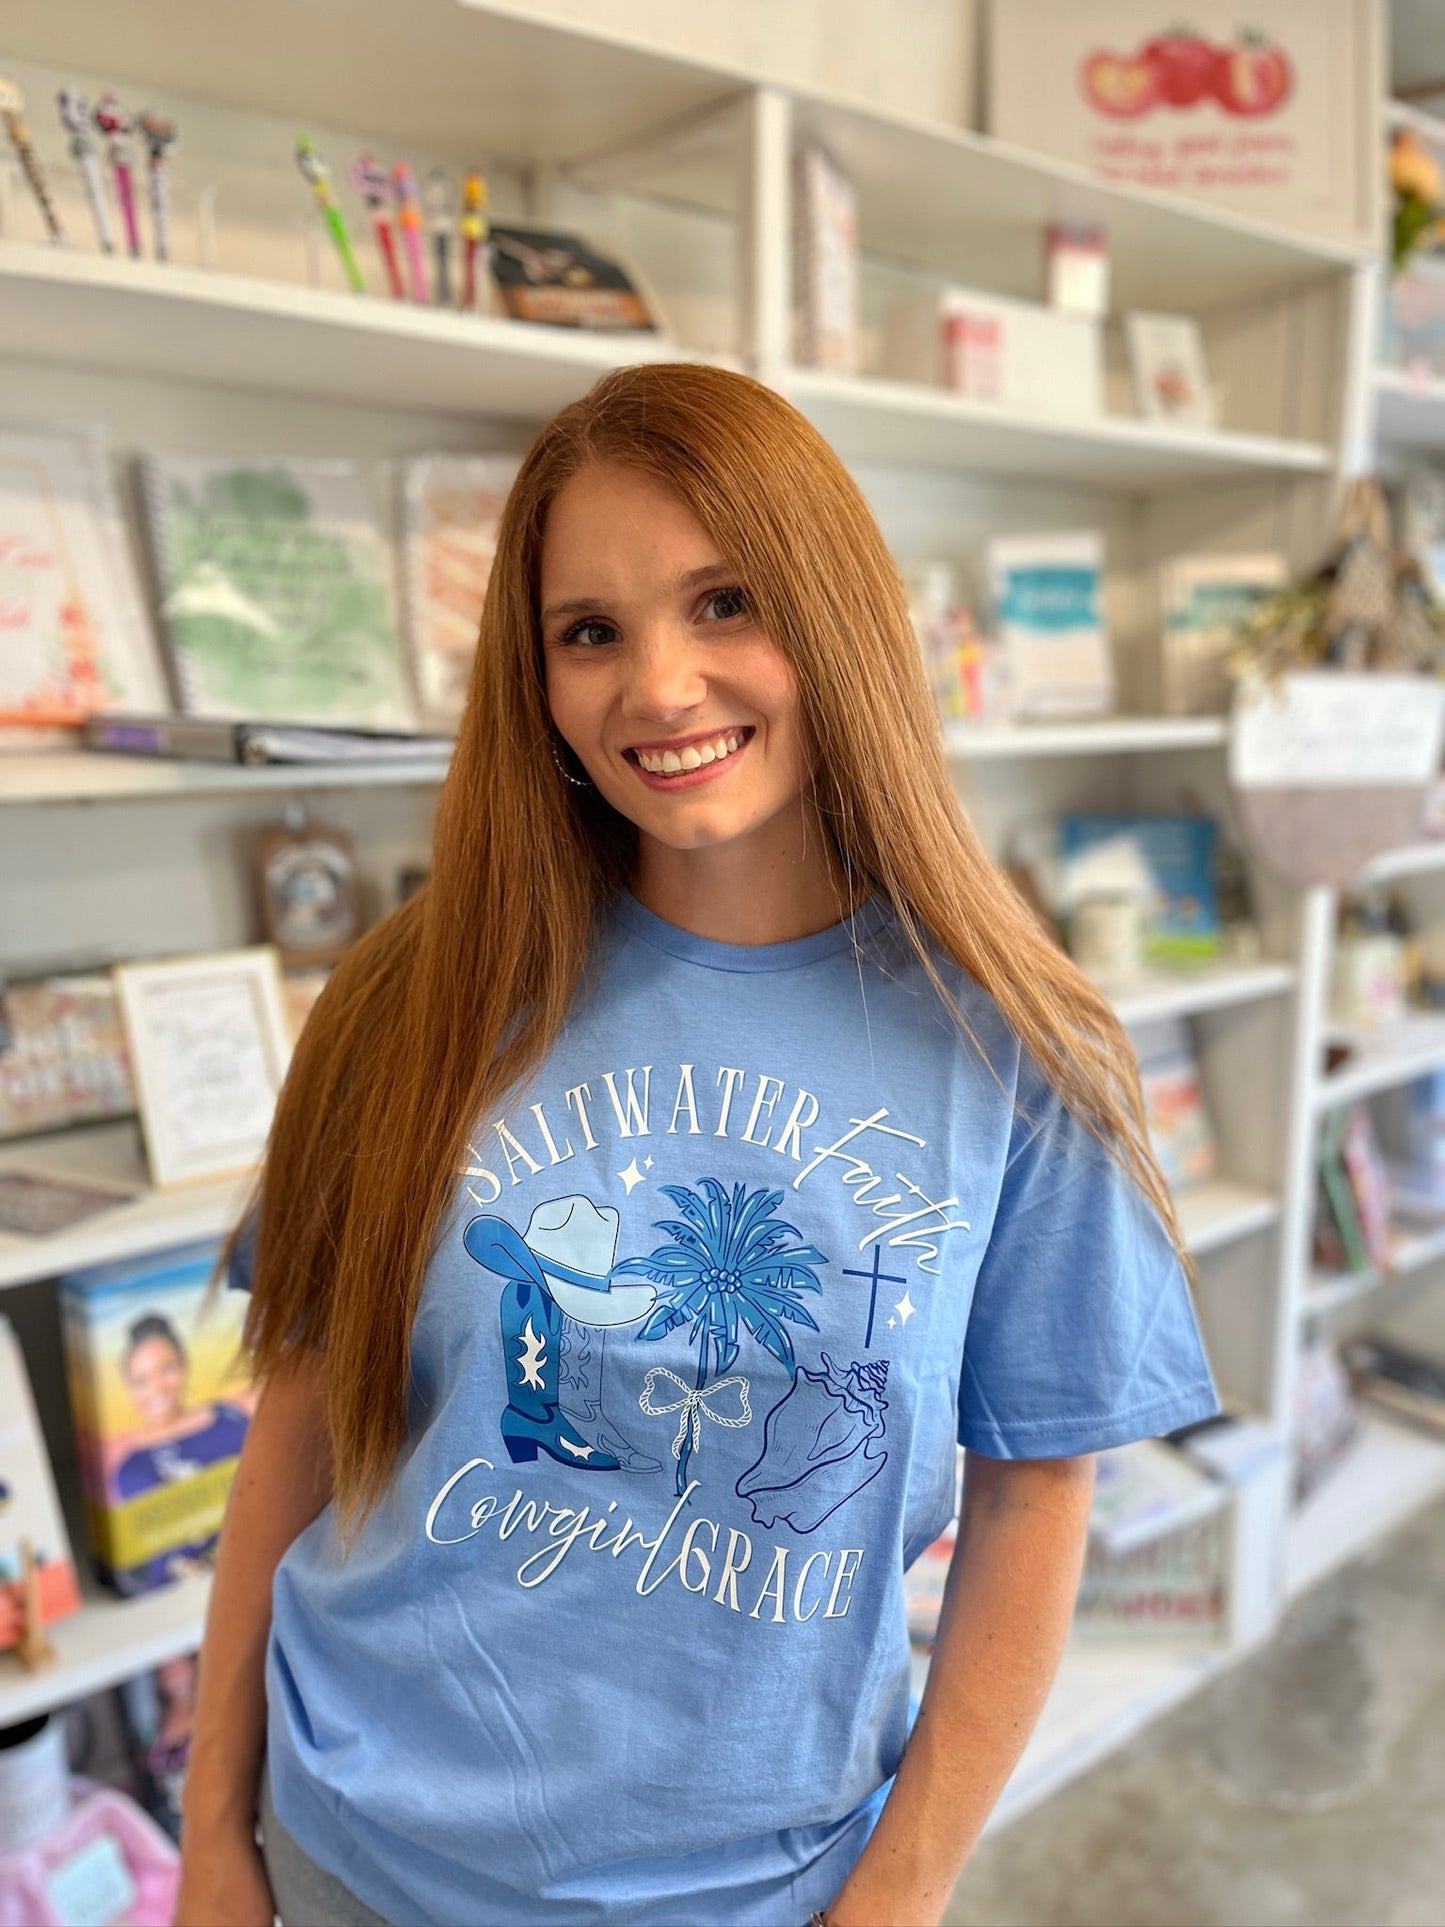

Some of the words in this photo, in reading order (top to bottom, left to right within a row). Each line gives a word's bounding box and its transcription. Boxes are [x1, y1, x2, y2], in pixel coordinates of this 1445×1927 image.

[458, 1064, 820, 1208] SALTWATER
[793, 1107, 970, 1274] Faith
[425, 1458, 701, 1596] Cowgirl
[680, 1519, 863, 1624] GRACE
